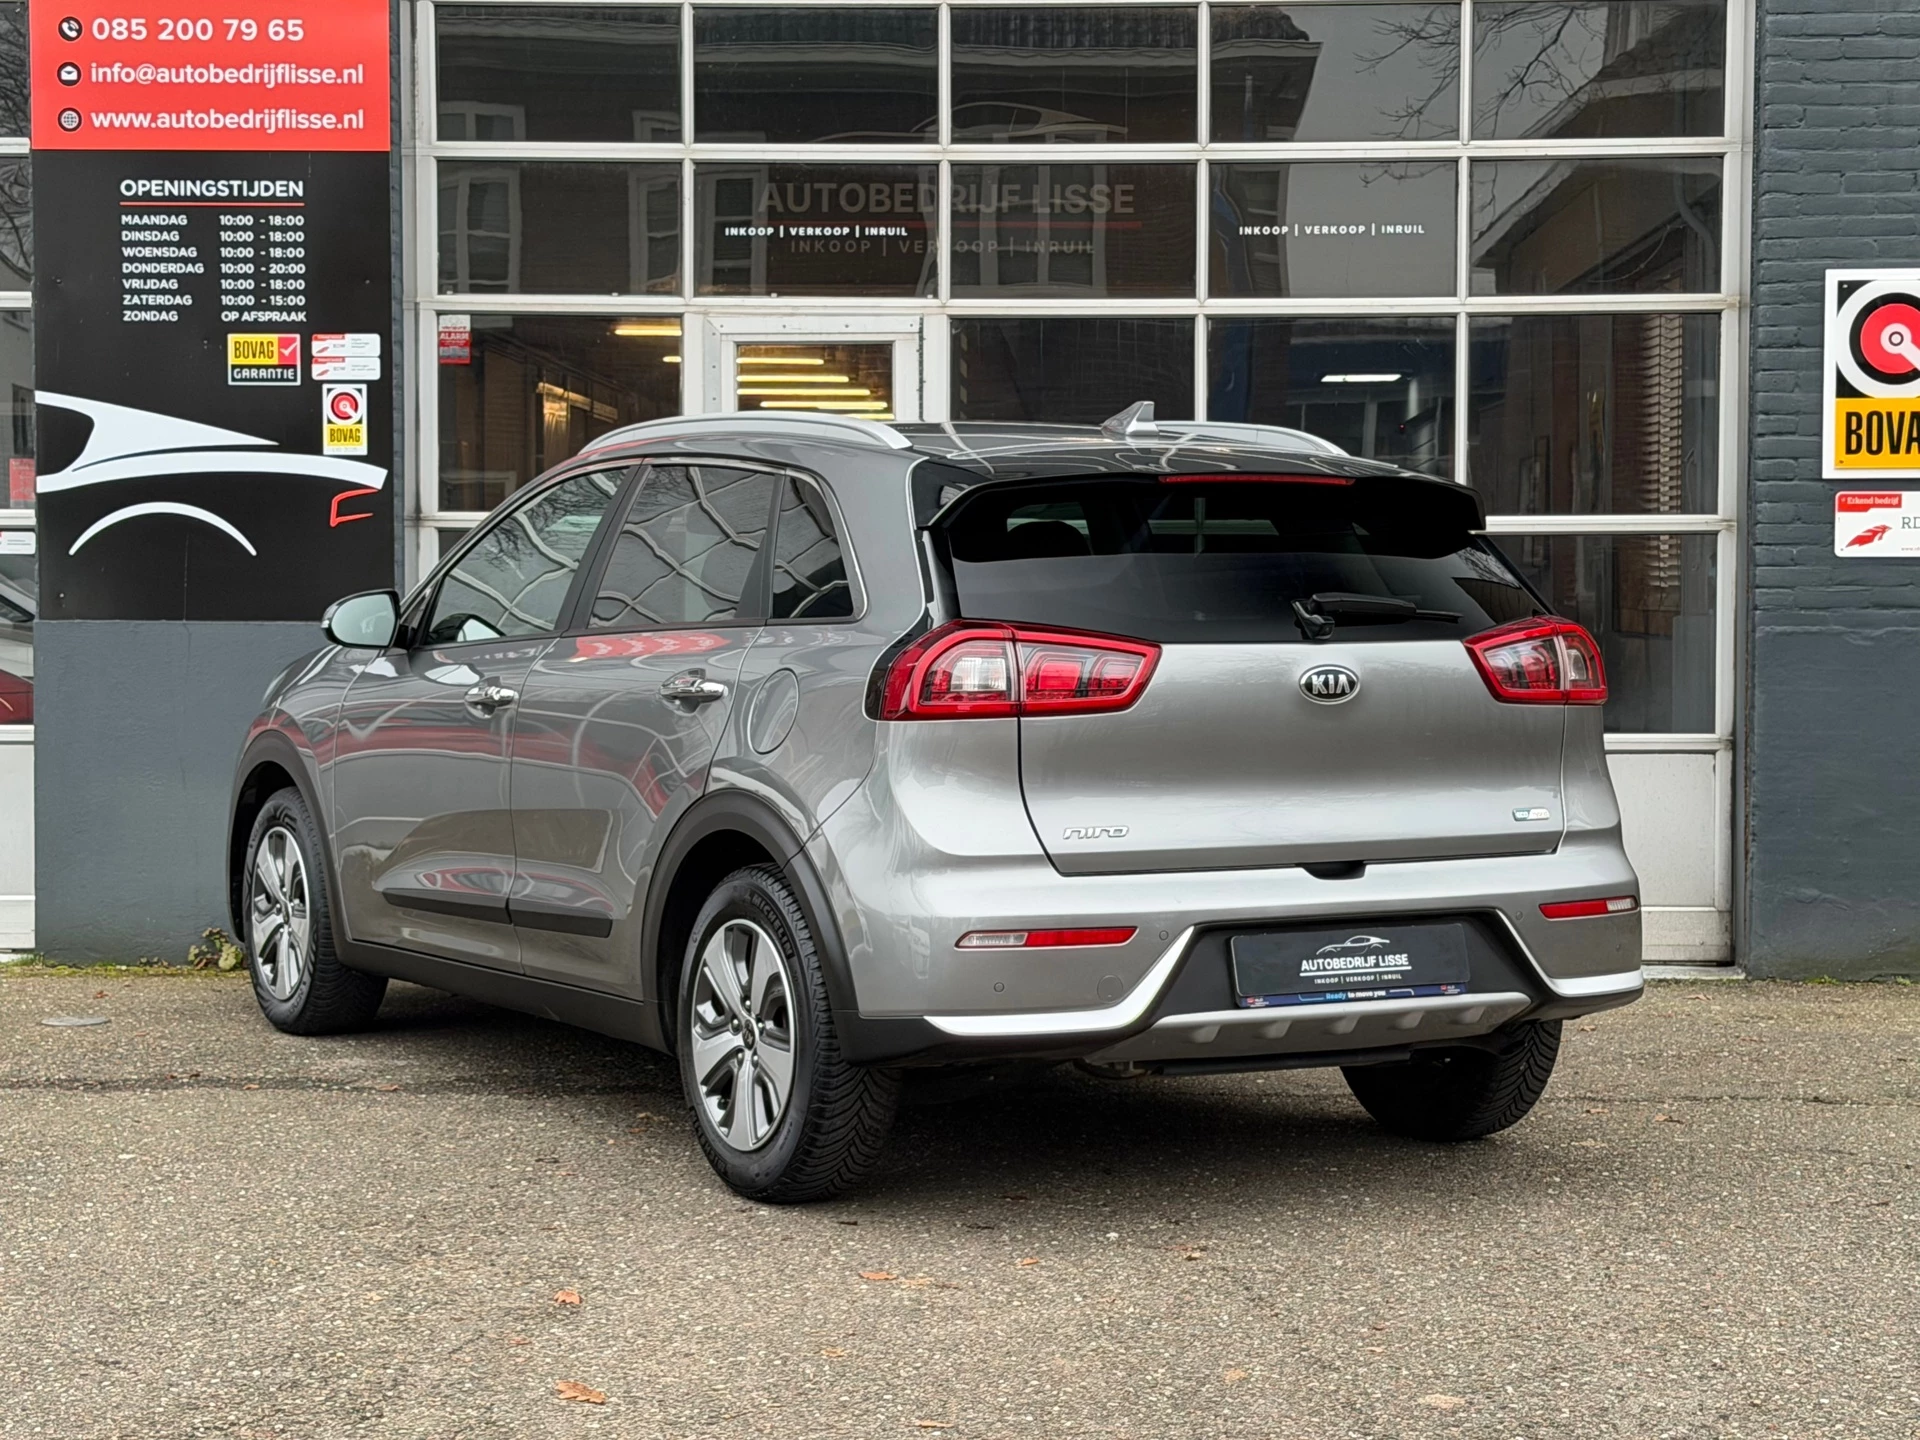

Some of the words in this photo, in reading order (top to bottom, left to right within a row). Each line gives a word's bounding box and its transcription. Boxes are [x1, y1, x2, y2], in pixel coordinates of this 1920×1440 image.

[92, 18, 148, 41] 085
[157, 18, 213, 41] 200
[223, 18, 258, 41] 79
[268, 18, 304, 41] 65
[91, 62, 364, 89] info@autobedrijflisse.nl
[91, 108, 364, 134] www.autobedrijflisse.nl
[120, 179, 304, 197] OPENINGSTIJDEN
[758, 182, 1021, 213] AUTOBEDRIJF
[1032, 184, 1135, 213] LISSE
[121, 215, 188, 225] MAANDAG
[219, 215, 254, 226] 10:00
[268, 215, 305, 226] 18:00
[725, 227, 774, 236] INKOOP
[789, 227, 850, 236] VERKOOP
[865, 227, 908, 236] INRUIL
[1239, 226, 1289, 235] INKOOP
[1304, 225, 1366, 235] VERKOOP
[1381, 224, 1425, 234] INRUIL
[121, 231, 180, 241] DINSDAG
[219, 231, 254, 242] 10:00
[268, 231, 305, 242] 18:00
[122, 247, 198, 257] WOENSDAG
[219, 247, 254, 258] 10:00
[268, 247, 305, 258] 18:00
[791, 240, 871, 253] INKOOP
[898, 240, 998, 253] VEROOP
[1026, 240, 1095, 254] INRUIL
[122, 263, 204, 273] DONDERDAG
[220, 263, 255, 274] 10:00
[269, 263, 306, 274] 20:00
[122, 279, 178, 289] VRIJDAG
[220, 279, 255, 290] 10:00
[269, 279, 306, 290] 18:00
[122, 295, 192, 305] ZATERDAG
[220, 295, 255, 306] 10:00
[269, 295, 306, 306] 15:00
[122, 311, 178, 321] ZONDAG
[221, 311, 239, 322] OP
[241, 311, 307, 322] AFSPRAAK
[234, 340, 274, 360] BOVAG
[233, 368, 295, 380] GARANTIE
[329, 428, 361, 443] BOVAG
[1311, 673, 1351, 694] KIA
[1301, 955, 1377, 971] AUTOBEDRIJF
[1379, 953, 1409, 966] LISSE
[1345, 975, 1375, 983] VERKOOP
[1326, 991, 1346, 1000] Ready
